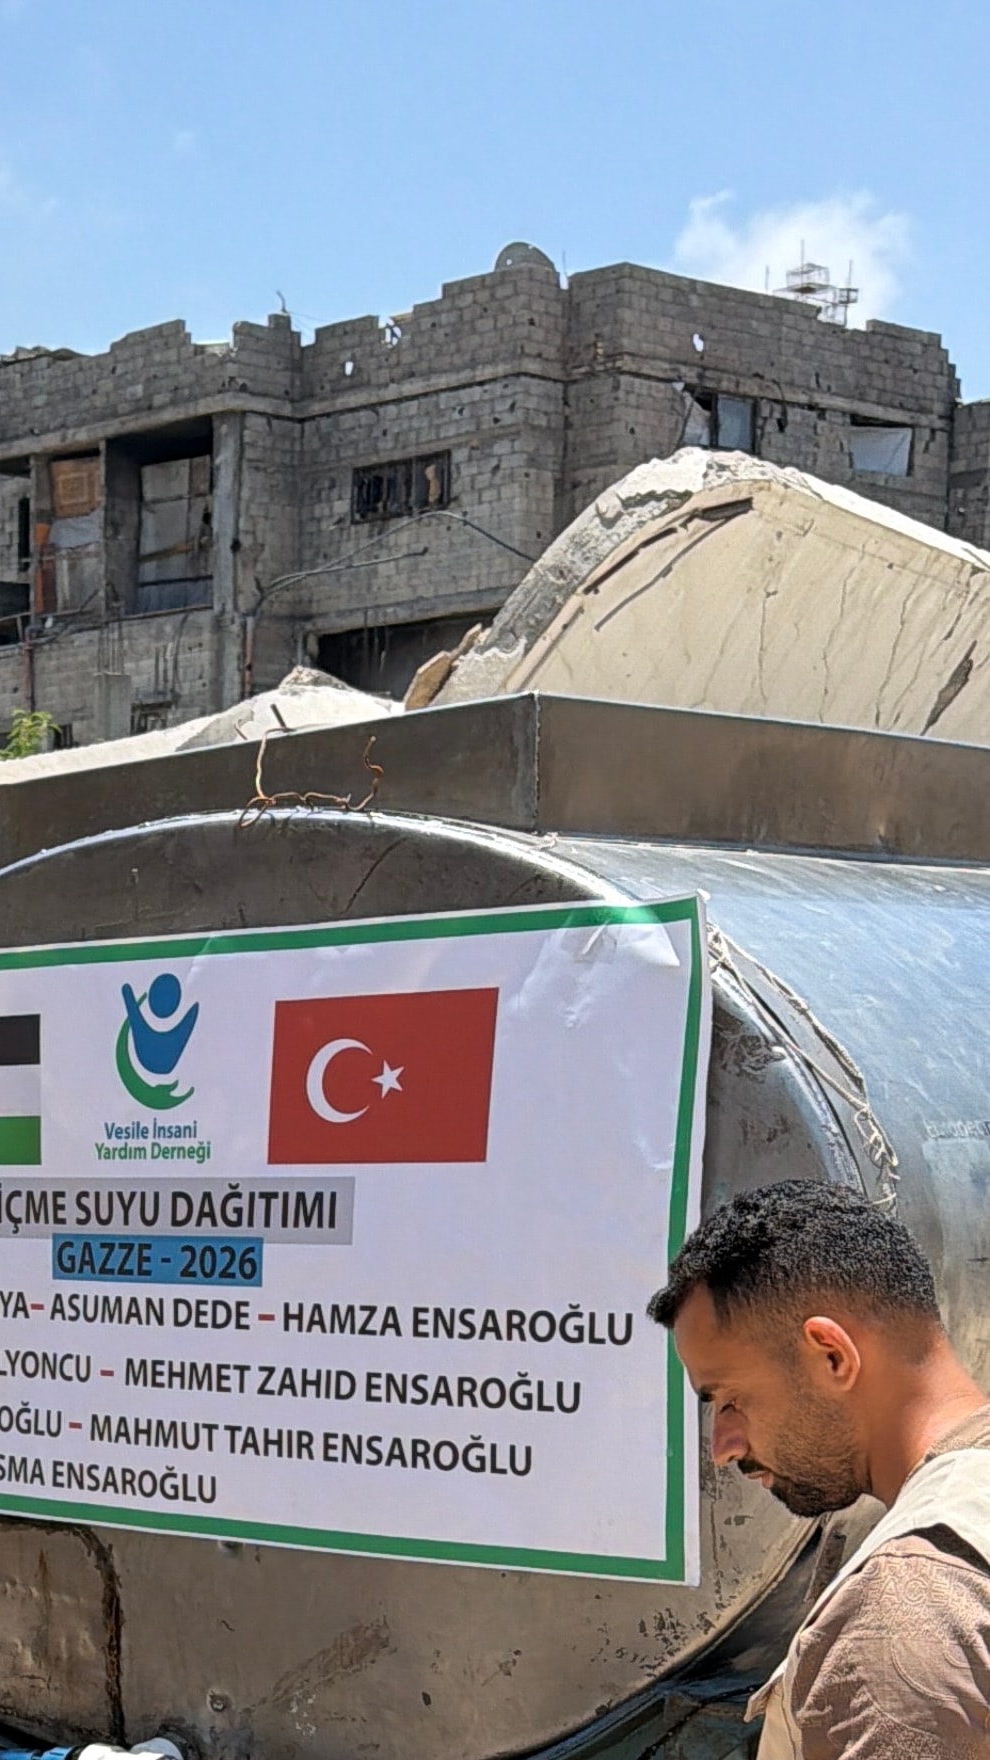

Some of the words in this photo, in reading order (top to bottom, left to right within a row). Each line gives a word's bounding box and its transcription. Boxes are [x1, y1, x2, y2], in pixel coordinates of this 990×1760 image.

[105, 1121, 149, 1140] Vesile
[153, 1118, 197, 1139] İnsani
[95, 1142, 147, 1160] Yardım
[151, 1141, 211, 1164] Derneği
[76, 1191, 159, 1226] SUYU
[171, 1183, 336, 1228] DAĞITIMI
[57, 1241, 152, 1276] GAZZE
[180, 1245, 257, 1279] 2026
[50, 1293, 164, 1326] ASUMAN
[173, 1298, 250, 1330] DEDE
[284, 1302, 402, 1337] HAMZA
[413, 1304, 632, 1345] ENSAROĞLU
[125, 1358, 251, 1393] MEHMET
[257, 1366, 356, 1400] ZAHID
[366, 1372, 580, 1413] ENSAROĞLU
[91, 1414, 219, 1451] MAHMUT
[224, 1425, 314, 1460] TAHIR
[323, 1432, 531, 1476] ENSAROĞLU
[52, 1465, 216, 1503] ENSAROĞLU
